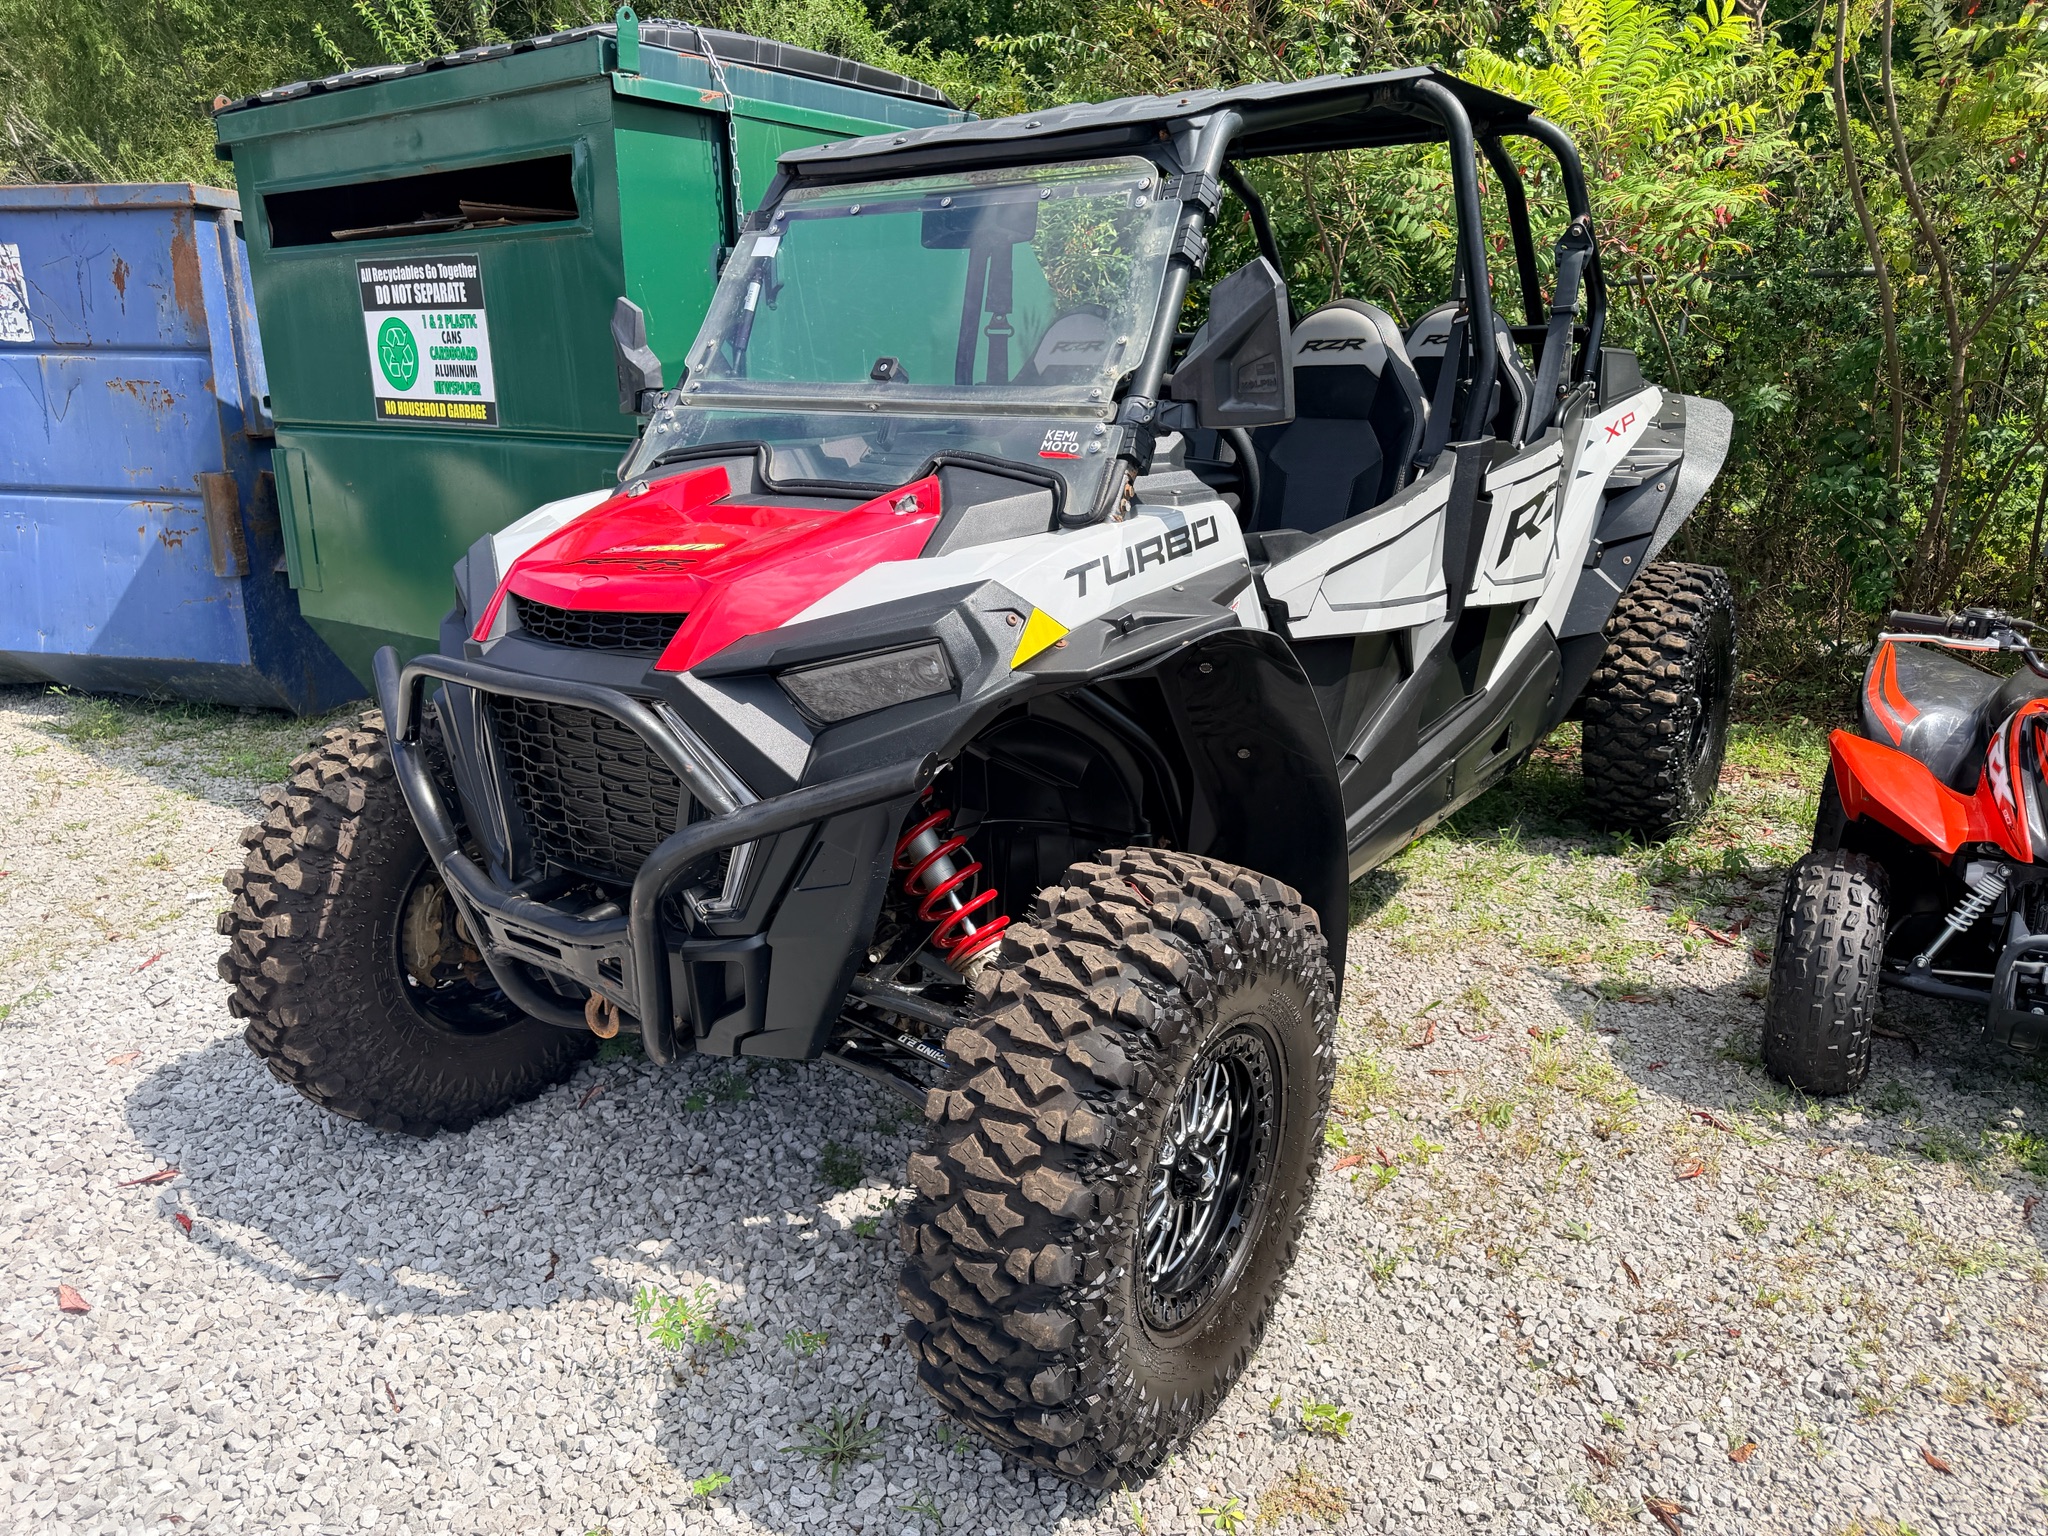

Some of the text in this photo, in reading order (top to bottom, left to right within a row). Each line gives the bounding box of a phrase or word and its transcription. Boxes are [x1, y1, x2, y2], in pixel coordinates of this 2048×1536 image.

[360, 262, 477, 283] All Recyclables Go Together
[375, 281, 467, 305] DO NOT SEPARATE
[421, 313, 478, 329] 1 & 2 PLASTIC
[441, 330, 462, 344] CANS
[429, 346, 478, 361] CARDBOARD
[1049, 341, 1106, 354] RZR
[1299, 338, 1367, 354] RZR
[435, 364, 478, 378] ALUMINUM
[433, 381, 482, 396] NEWSPAPER
[384, 400, 488, 420] NO HOUSEHOLD GARBAGE
[1604, 411, 1636, 444] XP
[1044, 429, 1079, 442] KEMI
[1040, 440, 1080, 453] MOTO
[1063, 515, 1220, 598] TURBO
